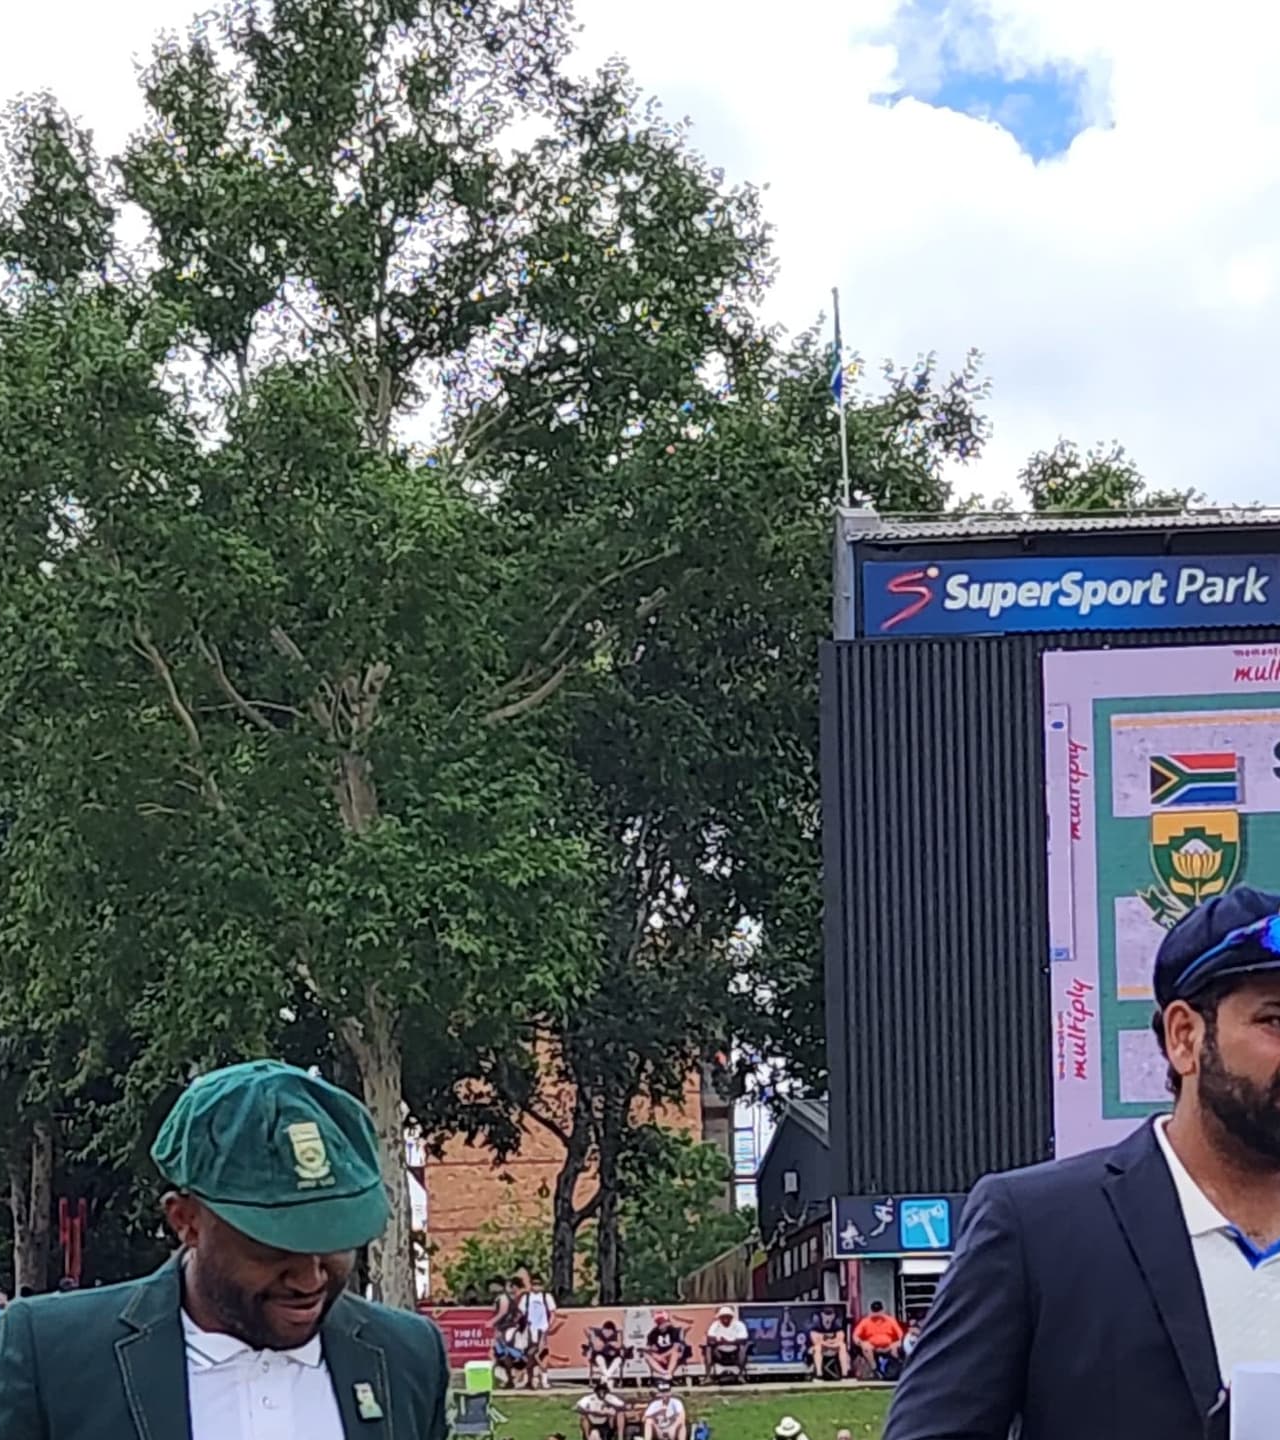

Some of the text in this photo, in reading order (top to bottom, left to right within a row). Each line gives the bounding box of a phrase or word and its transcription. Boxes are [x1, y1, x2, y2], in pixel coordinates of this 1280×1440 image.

[944, 566, 1270, 617] SuperSport Park
[1066, 978, 1094, 1080] multiply
